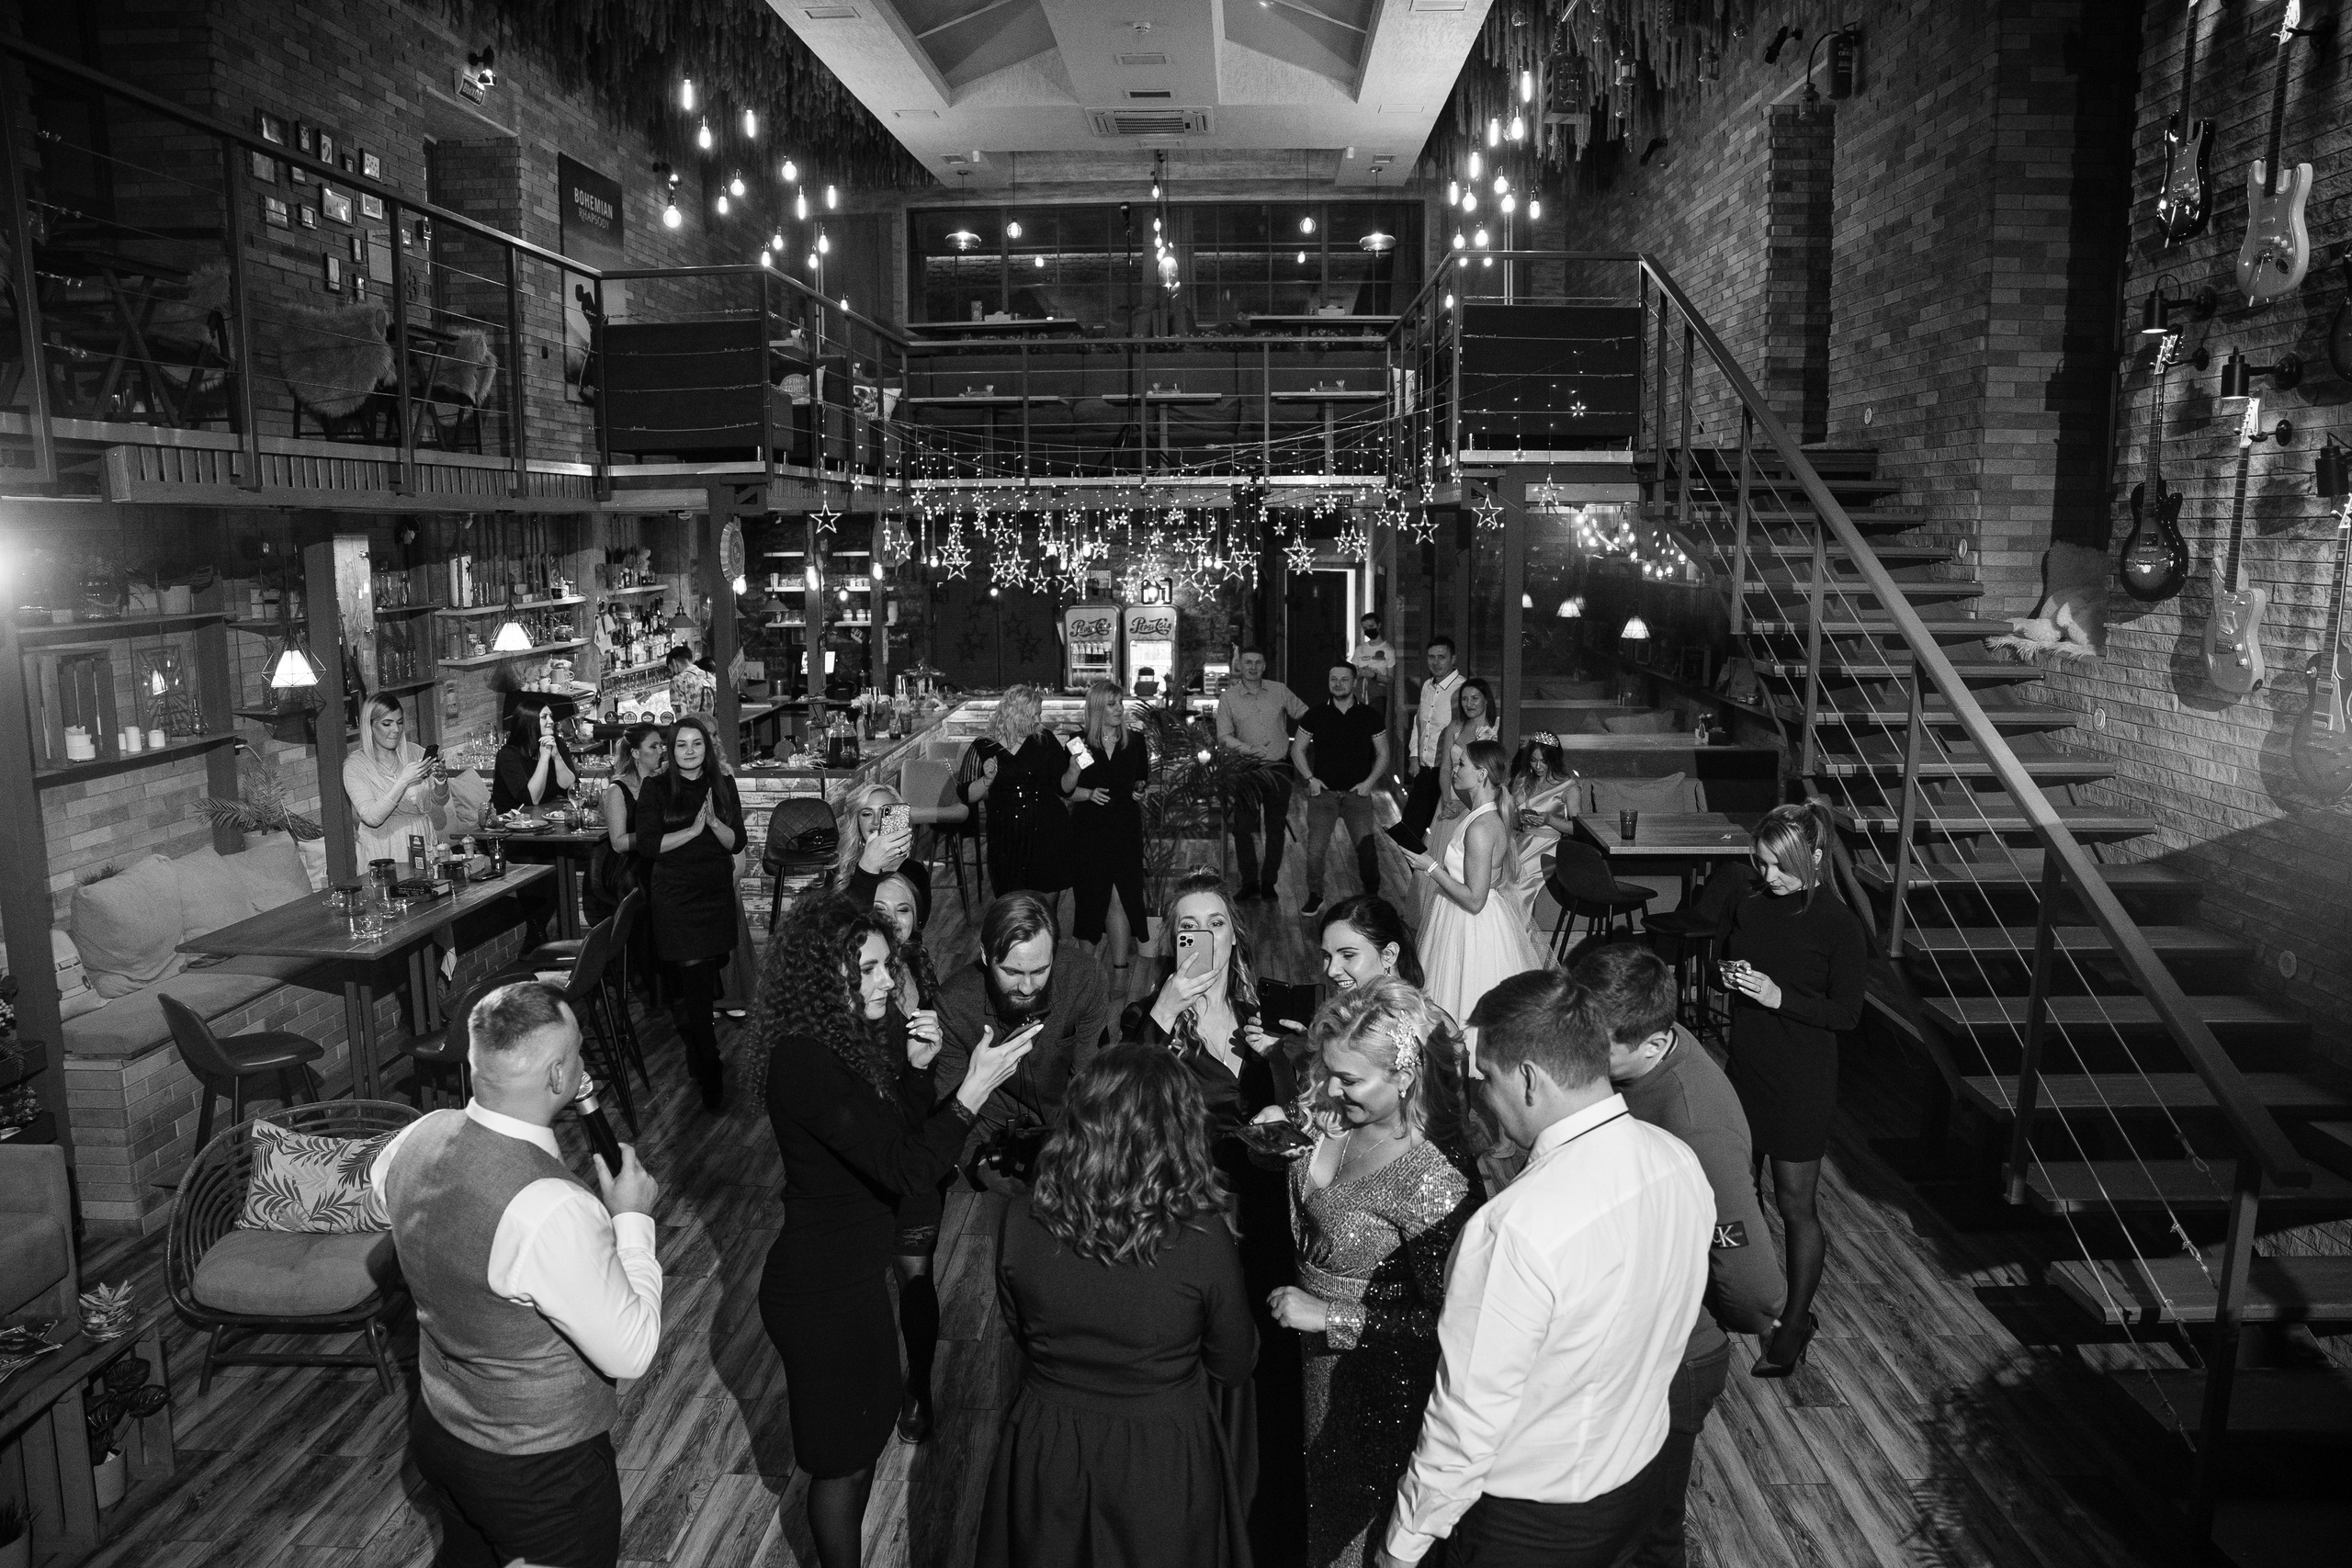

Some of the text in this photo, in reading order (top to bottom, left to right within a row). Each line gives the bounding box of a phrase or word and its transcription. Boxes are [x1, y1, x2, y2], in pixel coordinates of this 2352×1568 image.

[462, 82, 483, 104] ВЫХОД
[574, 186, 613, 220] BOHEMIAN
[578, 207, 610, 230] RHAPSODY
